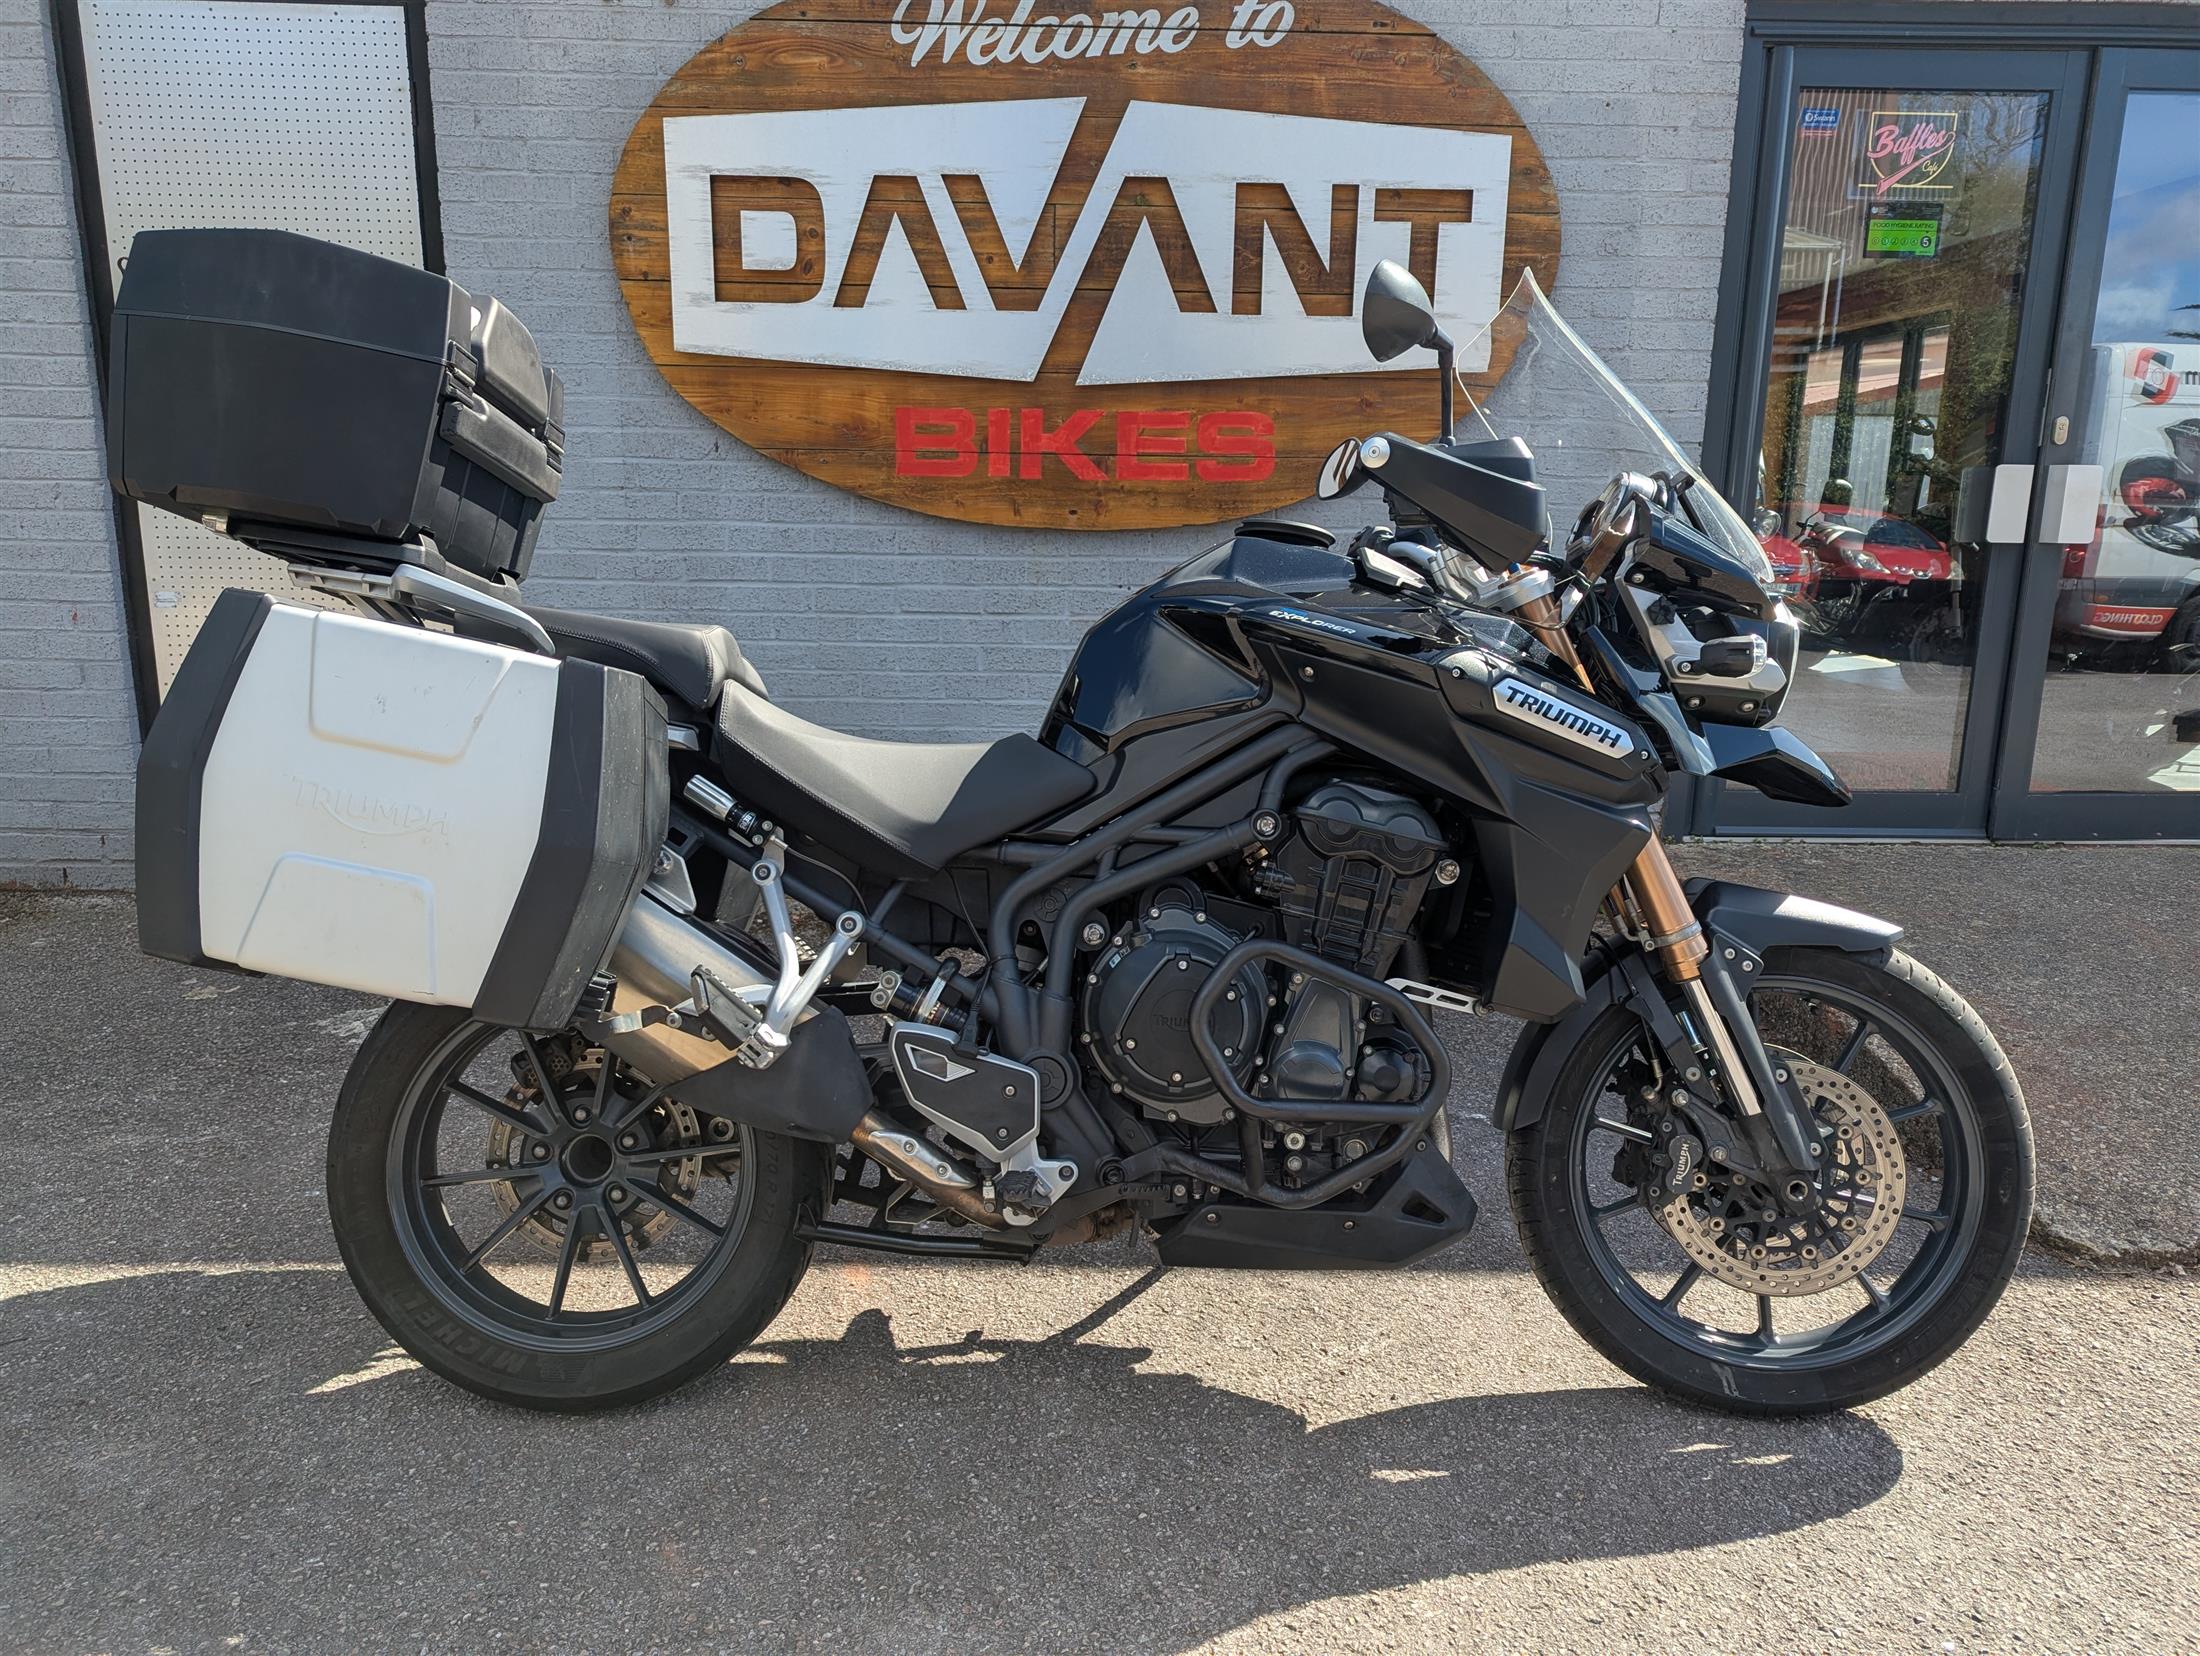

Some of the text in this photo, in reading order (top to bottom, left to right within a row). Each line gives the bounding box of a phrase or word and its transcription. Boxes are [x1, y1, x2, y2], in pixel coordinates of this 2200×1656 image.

[890, 0, 1295, 67] Welcome to
[1867, 122, 1948, 165] Baffles
[709, 173, 1474, 317] DAVANT
[1922, 237, 1929, 247] 5
[894, 407, 1276, 483] BIKES
[1269, 610, 1357, 634] EXPLORER
[1506, 686, 1622, 748] TRIUMPH
[289, 774, 449, 835] TRIUMPH
[1672, 1143, 1691, 1186] TRIUMPH
